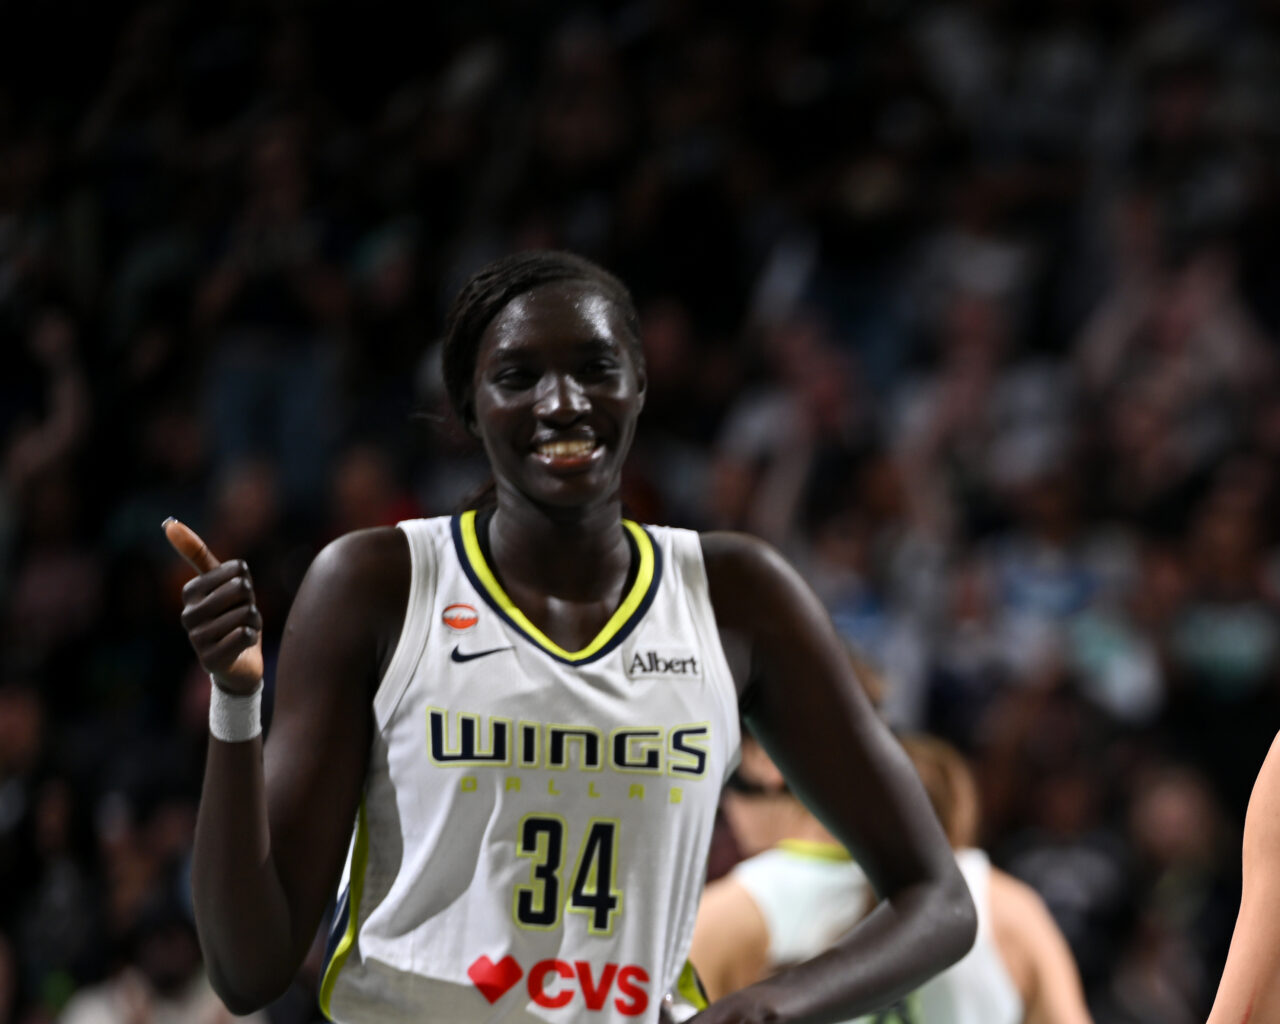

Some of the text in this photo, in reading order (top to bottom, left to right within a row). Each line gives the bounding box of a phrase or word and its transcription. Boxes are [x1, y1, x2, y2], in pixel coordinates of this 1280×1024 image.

[630, 653, 699, 676] Albert
[461, 777, 683, 804] DALLAS
[515, 813, 622, 935] 34
[528, 960, 649, 1016] CVS
